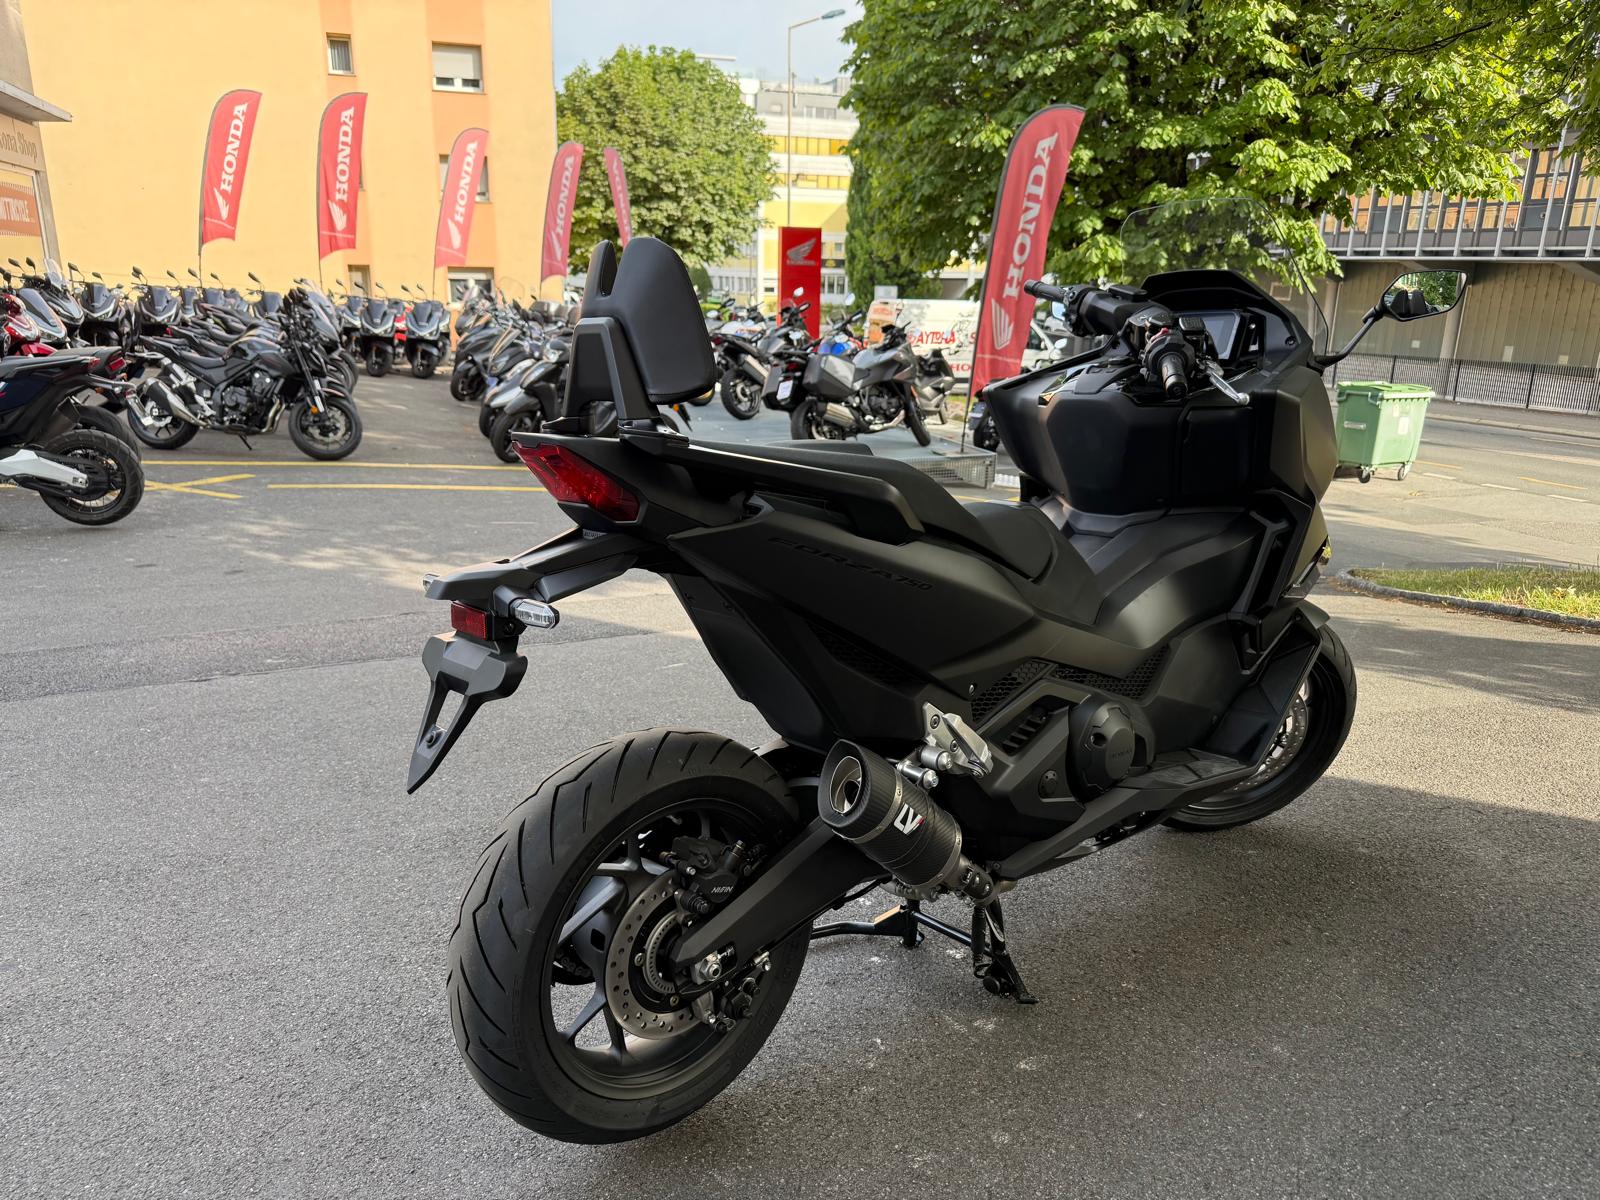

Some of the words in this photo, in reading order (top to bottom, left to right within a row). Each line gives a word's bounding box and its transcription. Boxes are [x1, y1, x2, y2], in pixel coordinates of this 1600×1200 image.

[220, 102, 248, 193] HONDA
[335, 105, 355, 202] HONDA
[454, 141, 478, 224] HONDA
[557, 155, 574, 235] HONDA
[1002, 132, 1058, 300] HONDA
[895, 574, 934, 591] 750
